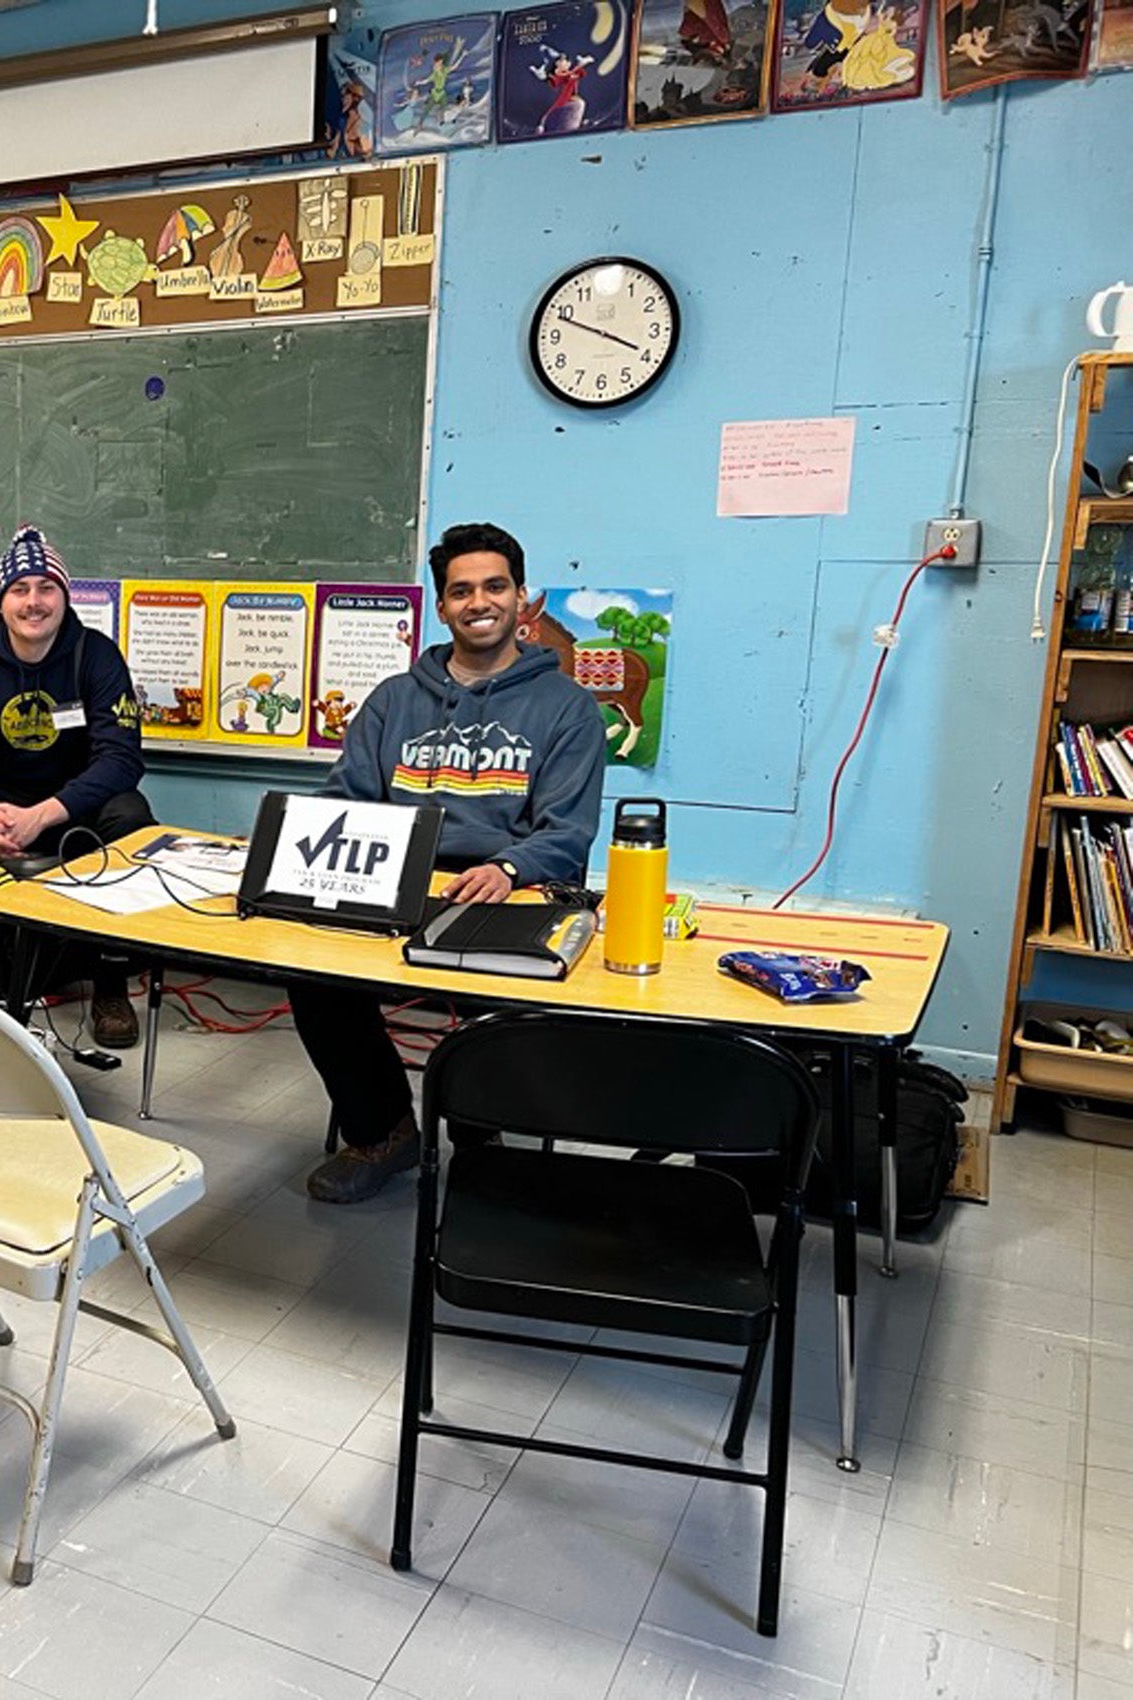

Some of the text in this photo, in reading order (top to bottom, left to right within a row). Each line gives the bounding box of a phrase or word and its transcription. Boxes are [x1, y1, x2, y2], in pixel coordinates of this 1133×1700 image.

[389, 243, 431, 260] Zipper
[52, 277, 80, 296] Star
[213, 279, 254, 294] Violin
[577, 287, 591, 302] 11
[627, 282, 634, 297] 1
[96, 302, 137, 321] Turtle
[643, 296, 655, 313] 2
[557, 305, 574, 321] 10
[550, 329, 561, 345] 9
[649, 323, 660, 339] 3
[555, 353, 566, 369] 8
[640, 349, 651, 363] 4
[575, 370, 585, 385] 7
[596, 374, 607, 390] 6
[620, 367, 631, 383] 5
[333, 598, 354, 607] Little
[356, 598, 374, 607] Jack
[401, 743, 532, 771] VERMONT
